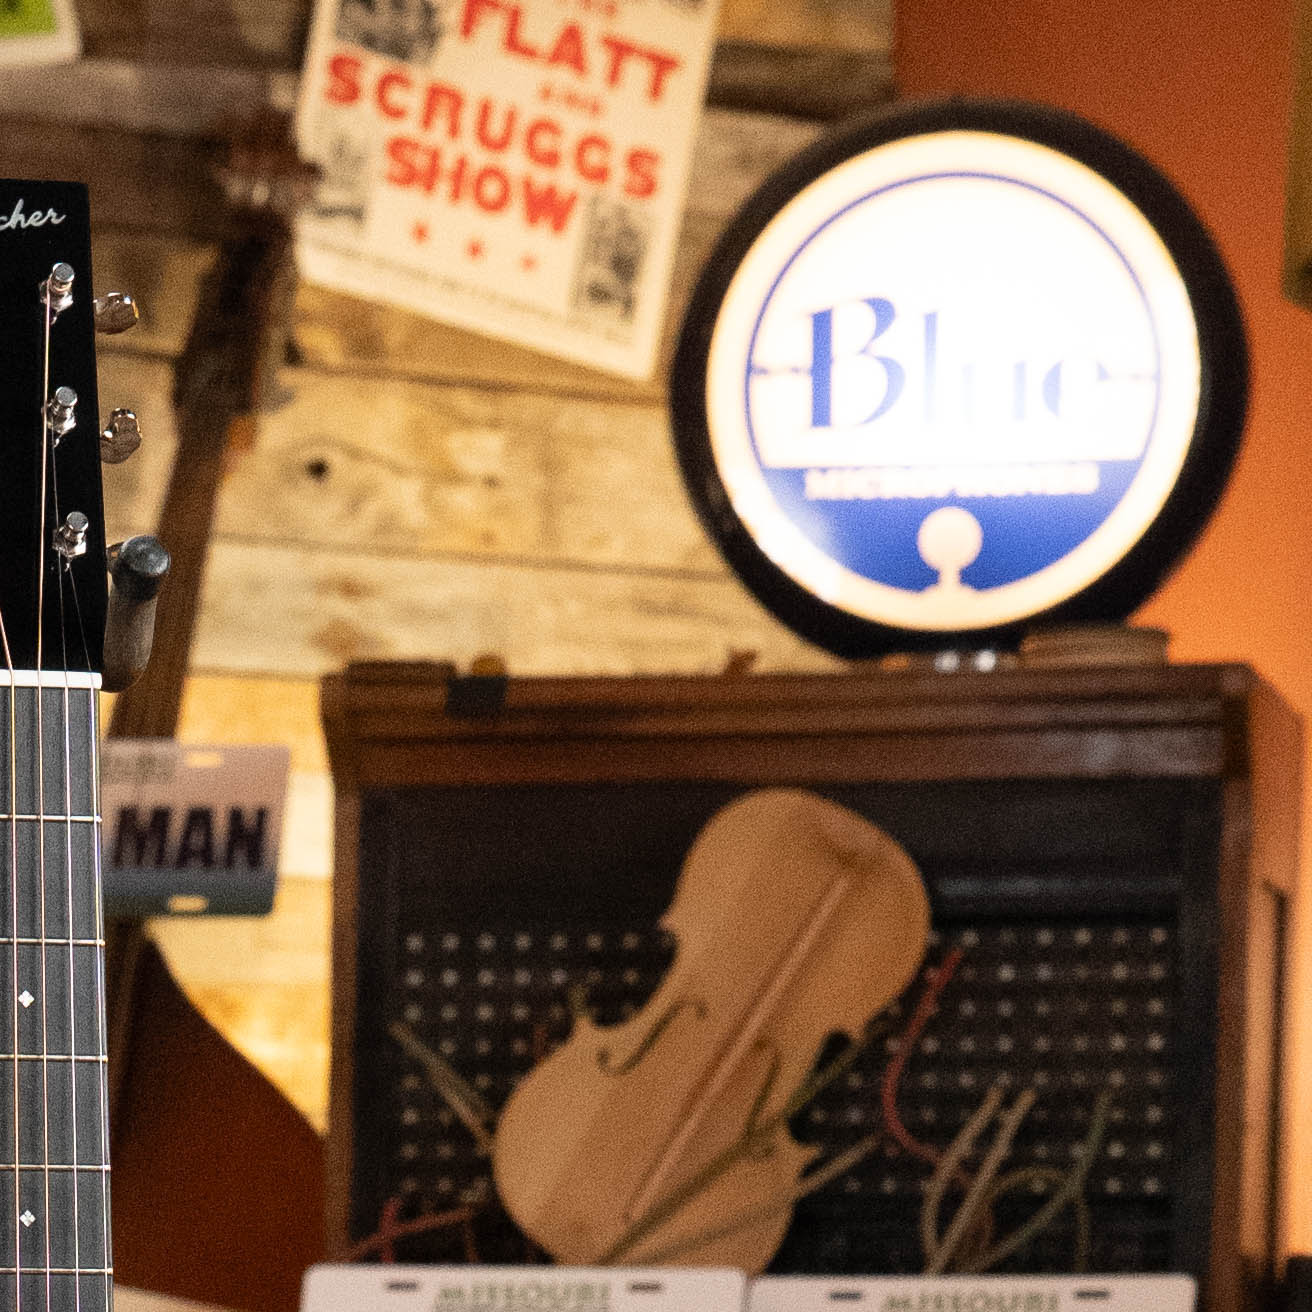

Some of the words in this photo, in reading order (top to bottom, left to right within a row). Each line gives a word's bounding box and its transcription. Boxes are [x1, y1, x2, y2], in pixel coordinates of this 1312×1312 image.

[460, 0, 682, 102] FLATT
[324, 52, 660, 198] SCRUGGS
[383, 135, 578, 234] SHOW
[112, 806, 268, 870] MAN
